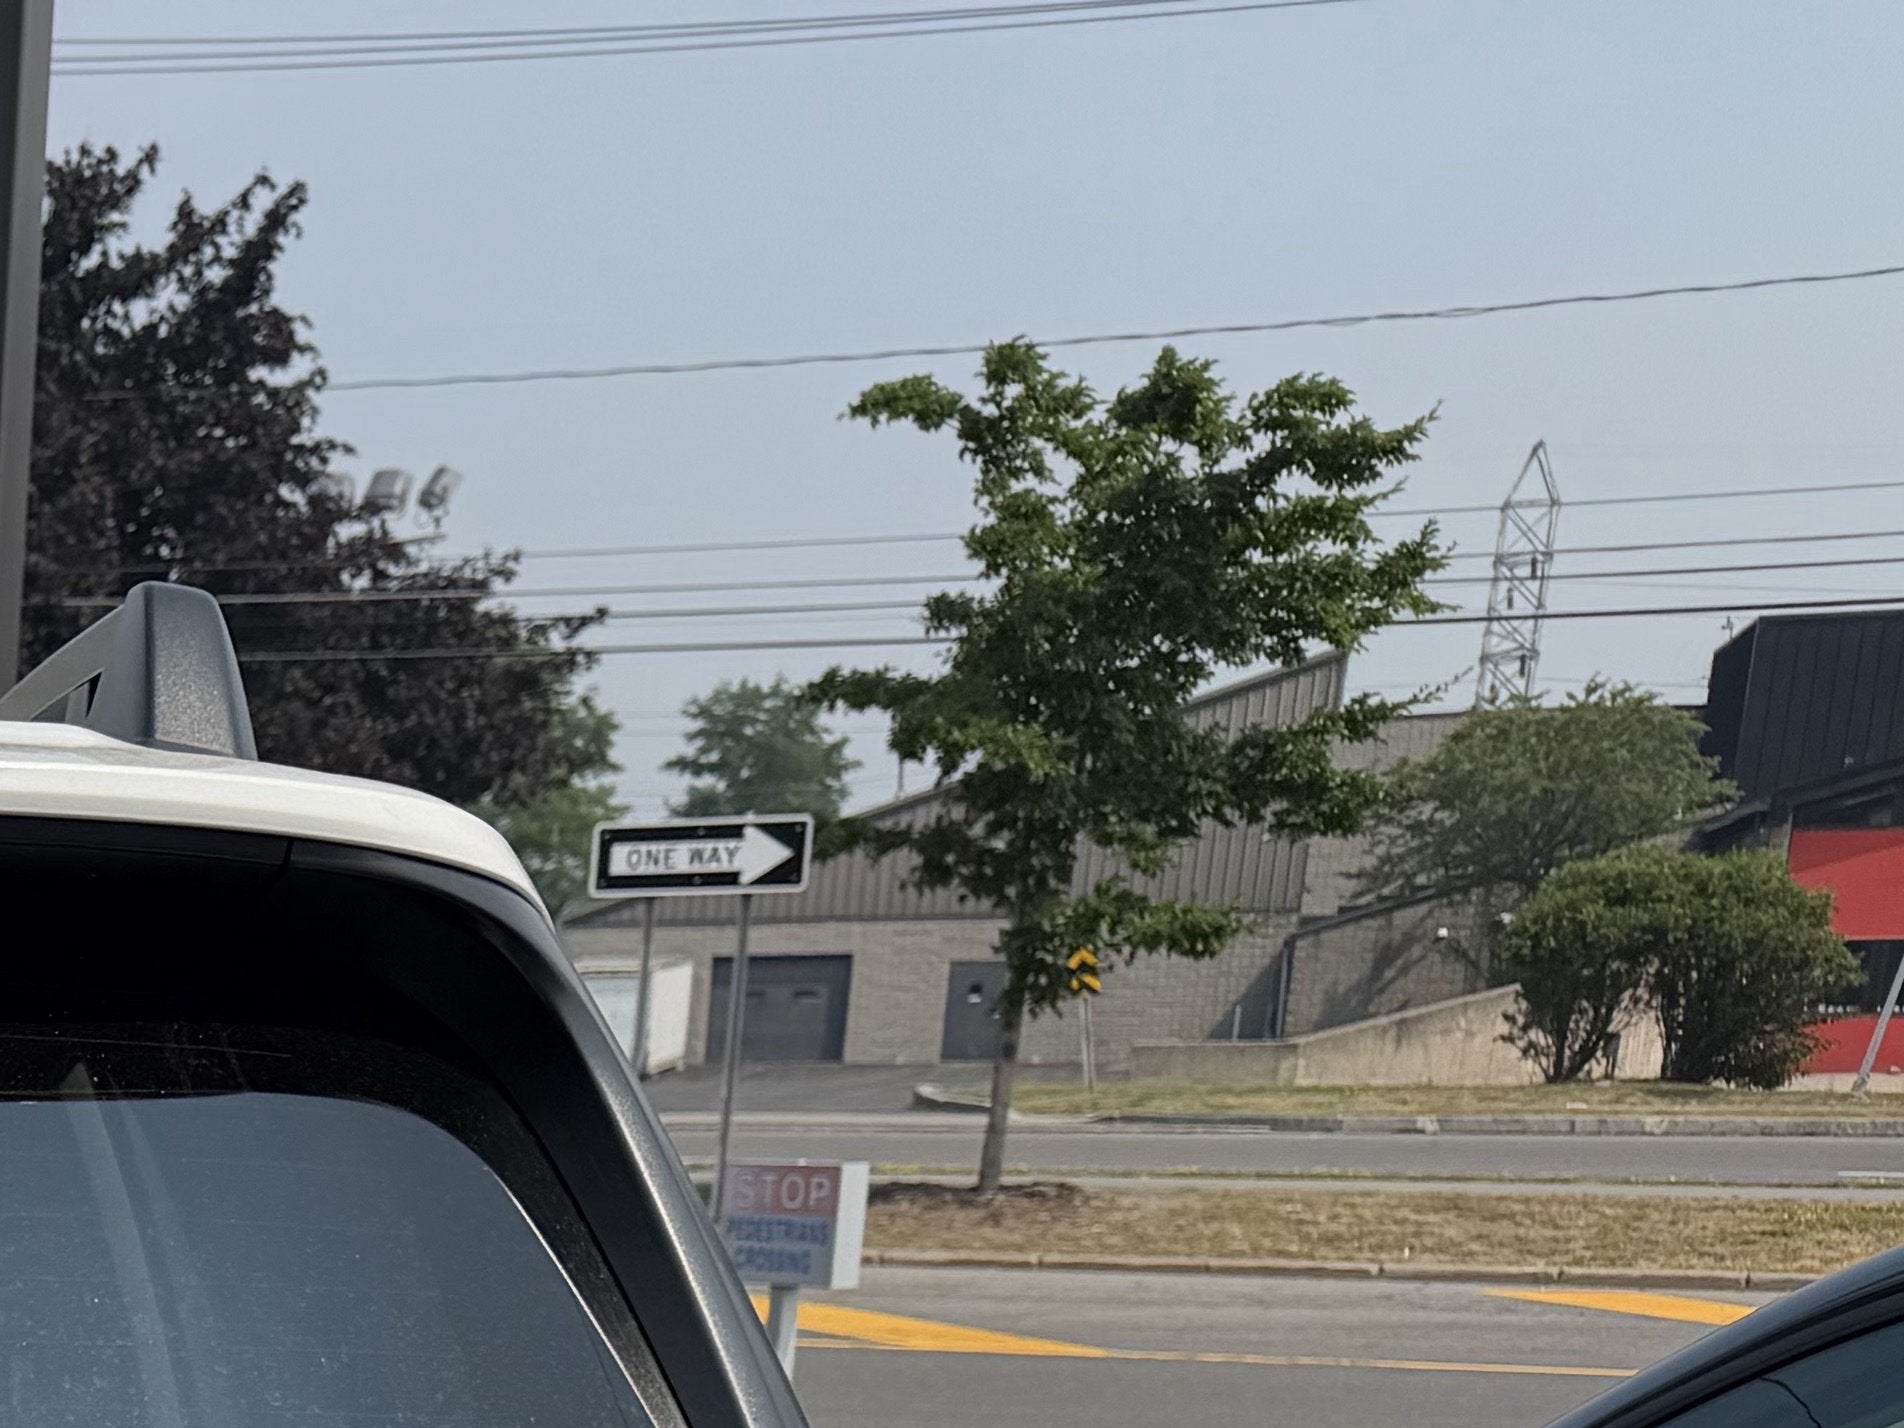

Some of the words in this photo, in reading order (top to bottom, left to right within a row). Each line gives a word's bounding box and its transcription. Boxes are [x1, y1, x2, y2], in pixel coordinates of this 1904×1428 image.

[625, 848, 678, 871] ONE
[688, 845, 742, 866] WAY
[732, 1170, 832, 1210] STOP
